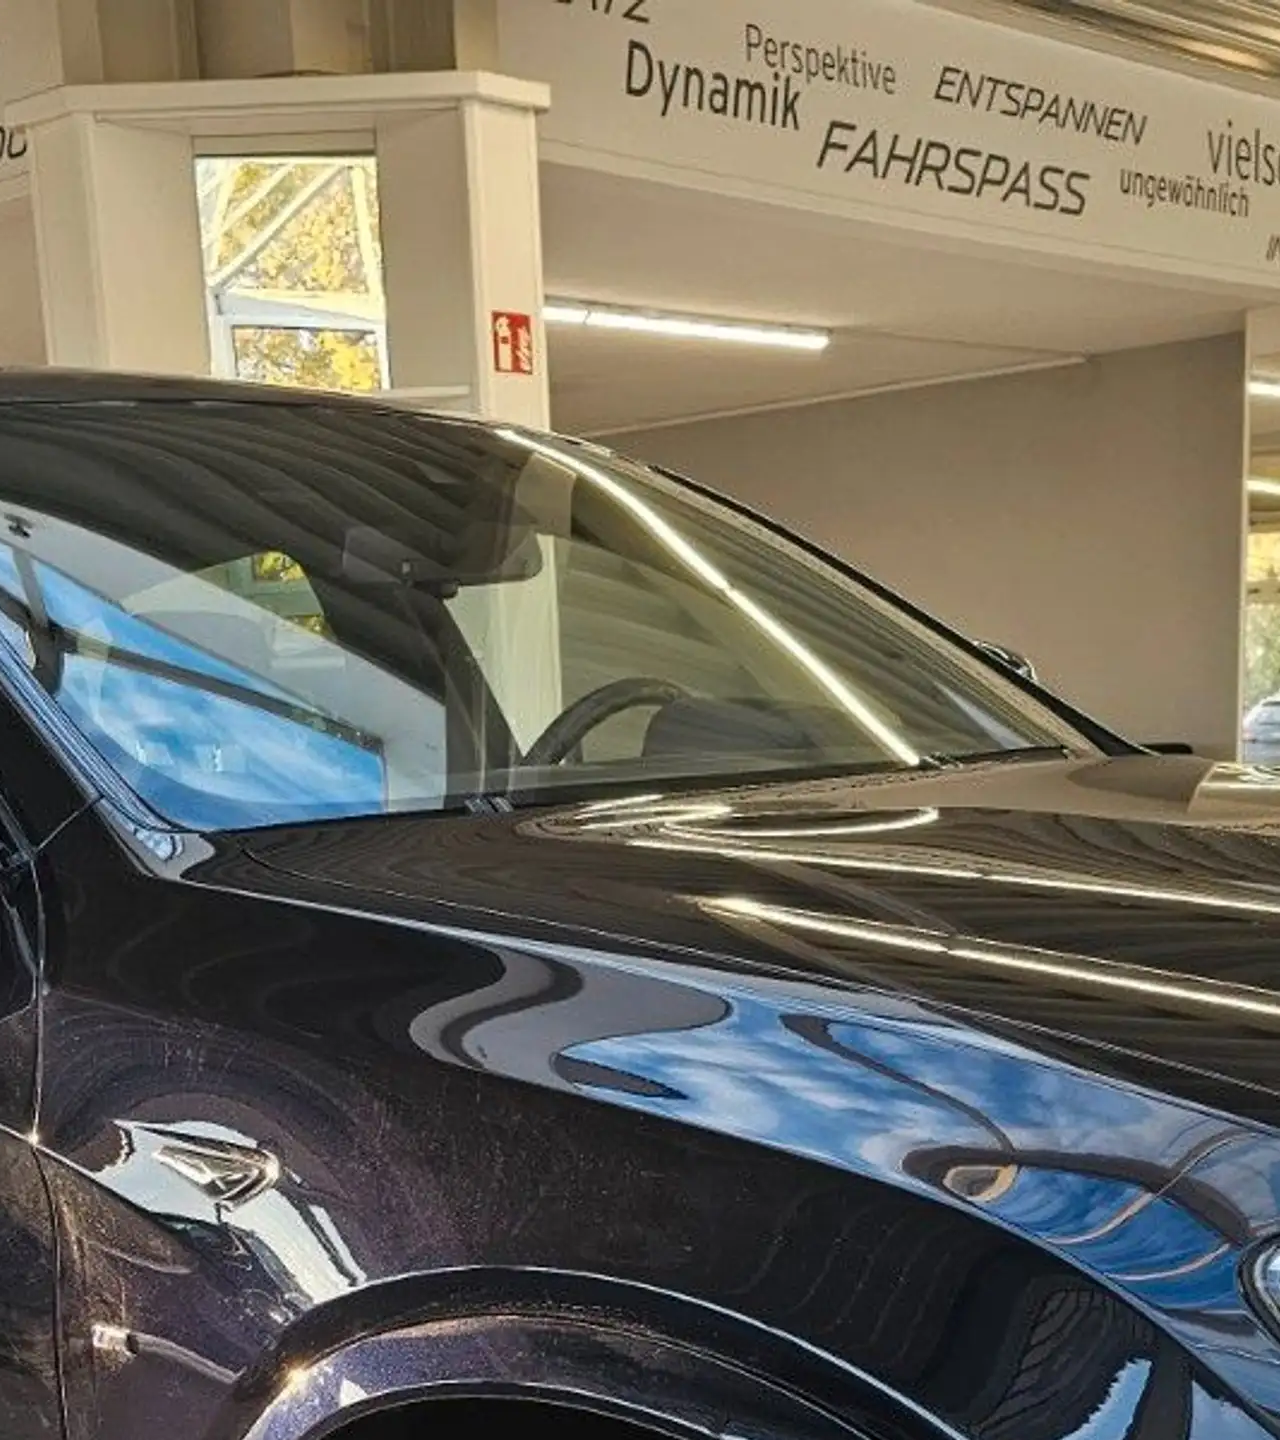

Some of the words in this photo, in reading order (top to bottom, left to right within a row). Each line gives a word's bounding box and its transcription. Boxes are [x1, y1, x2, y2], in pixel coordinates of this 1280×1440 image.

[626, 39, 800, 131] Dynamik
[746, 24, 896, 94] Perspektive
[934, 66, 1147, 145] ENTSPANNEN
[816, 120, 1091, 216] FAHRSPASS
[1120, 169, 1249, 217] ungewöhnlich
